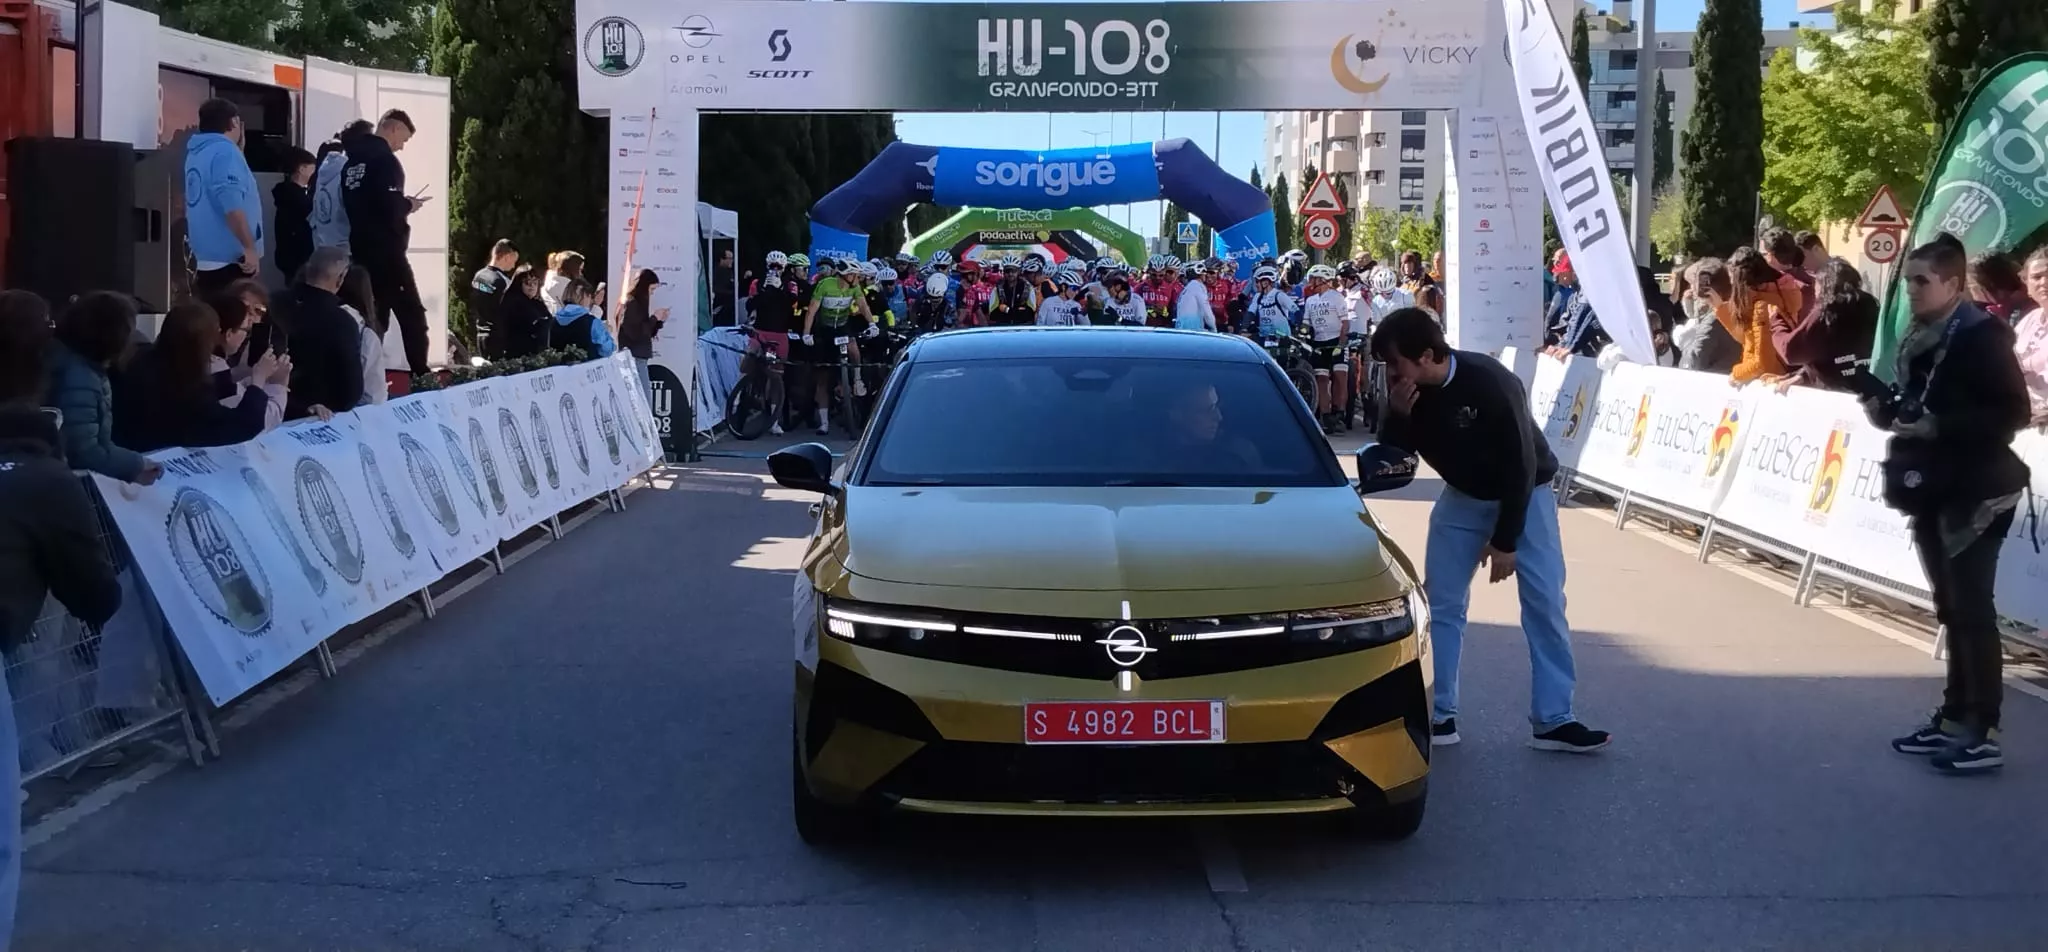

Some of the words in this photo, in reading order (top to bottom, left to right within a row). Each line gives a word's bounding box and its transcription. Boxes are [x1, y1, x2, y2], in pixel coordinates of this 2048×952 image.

[604, 27, 623, 43] HU
[978, 19, 1170, 76] HU-108
[670, 54, 725, 64] OPEL
[747, 70, 814, 78] SCOTT
[1531, 66, 1610, 252] GOBIK
[1953, 149, 1996, 173] GRAN
[1993, 168, 2044, 208] FONDO
[1950, 191, 1988, 224] HU
[979, 230, 1035, 241] podoactiva
[1312, 226, 1332, 238] 20
[1938, 212, 1971, 236] 108
[1871, 240, 1893, 251] 20
[1651, 412, 1715, 456] Huesca
[206, 549, 241, 580] 108
[1033, 710, 1048, 736] S
[1067, 710, 1135, 736] 4982
[1153, 710, 1207, 735] BCL
